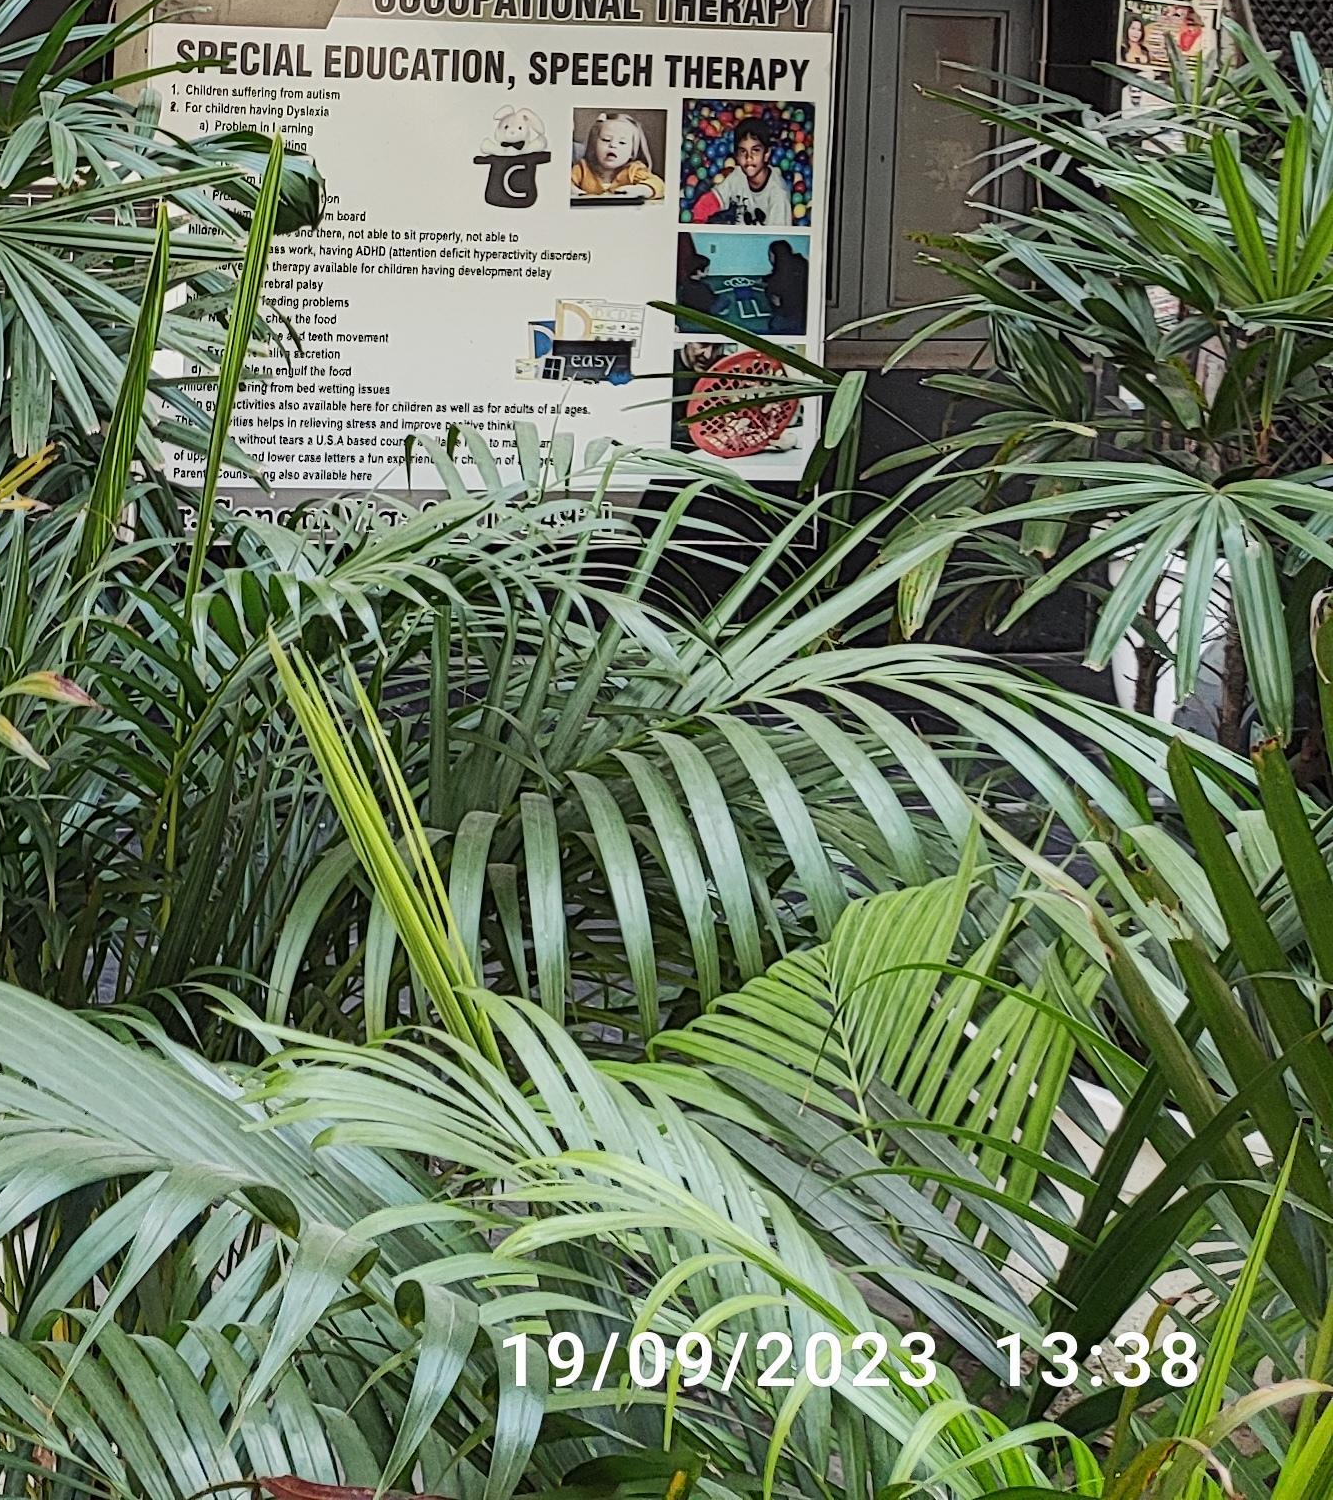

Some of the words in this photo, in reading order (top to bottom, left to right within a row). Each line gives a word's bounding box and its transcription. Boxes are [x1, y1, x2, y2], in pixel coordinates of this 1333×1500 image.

[176, 40, 312, 79] SPECIAL
[320, 41, 517, 91] EDUCATION,
[528, 50, 654, 88] SPEECH
[664, 53, 810, 93] THERAPY
[185, 84, 229, 97] Children
[231, 86, 277, 101] suffering
[280, 87, 304, 99] from
[306, 89, 341, 100] autism
[185, 101, 202, 113] For
[205, 102, 246, 115] children
[249, 104, 284, 119] having
[286, 105, 329, 119] Dyslexia
[570, 354, 617, 376] easy
[270, 382, 294, 393] from
[296, 382, 316, 394] bed
[318, 384, 355, 397] wetting
[358, 383, 390, 395] issues
